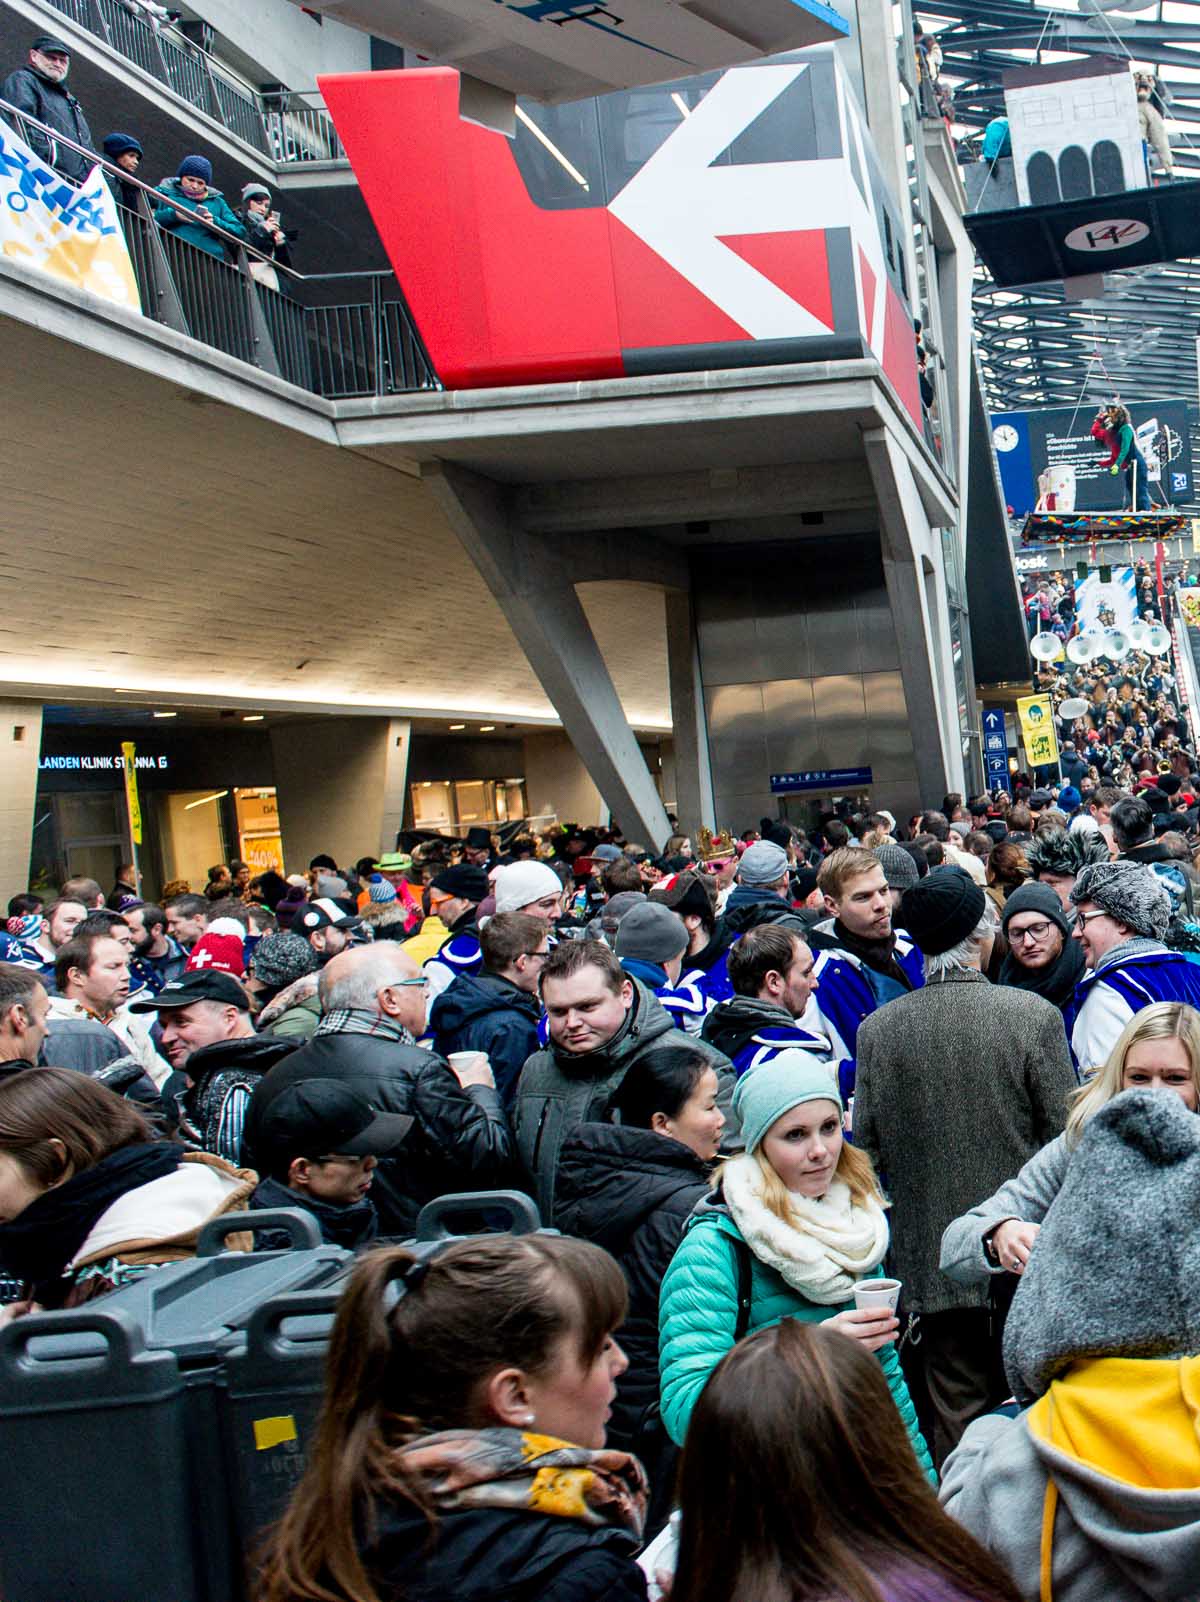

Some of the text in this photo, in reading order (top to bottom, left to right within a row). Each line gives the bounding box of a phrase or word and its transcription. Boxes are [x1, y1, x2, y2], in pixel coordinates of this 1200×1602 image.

[1015, 554, 1049, 570] iosk
[81, 756, 113, 769] KLINIK
[133, 756, 156, 769] NNA
